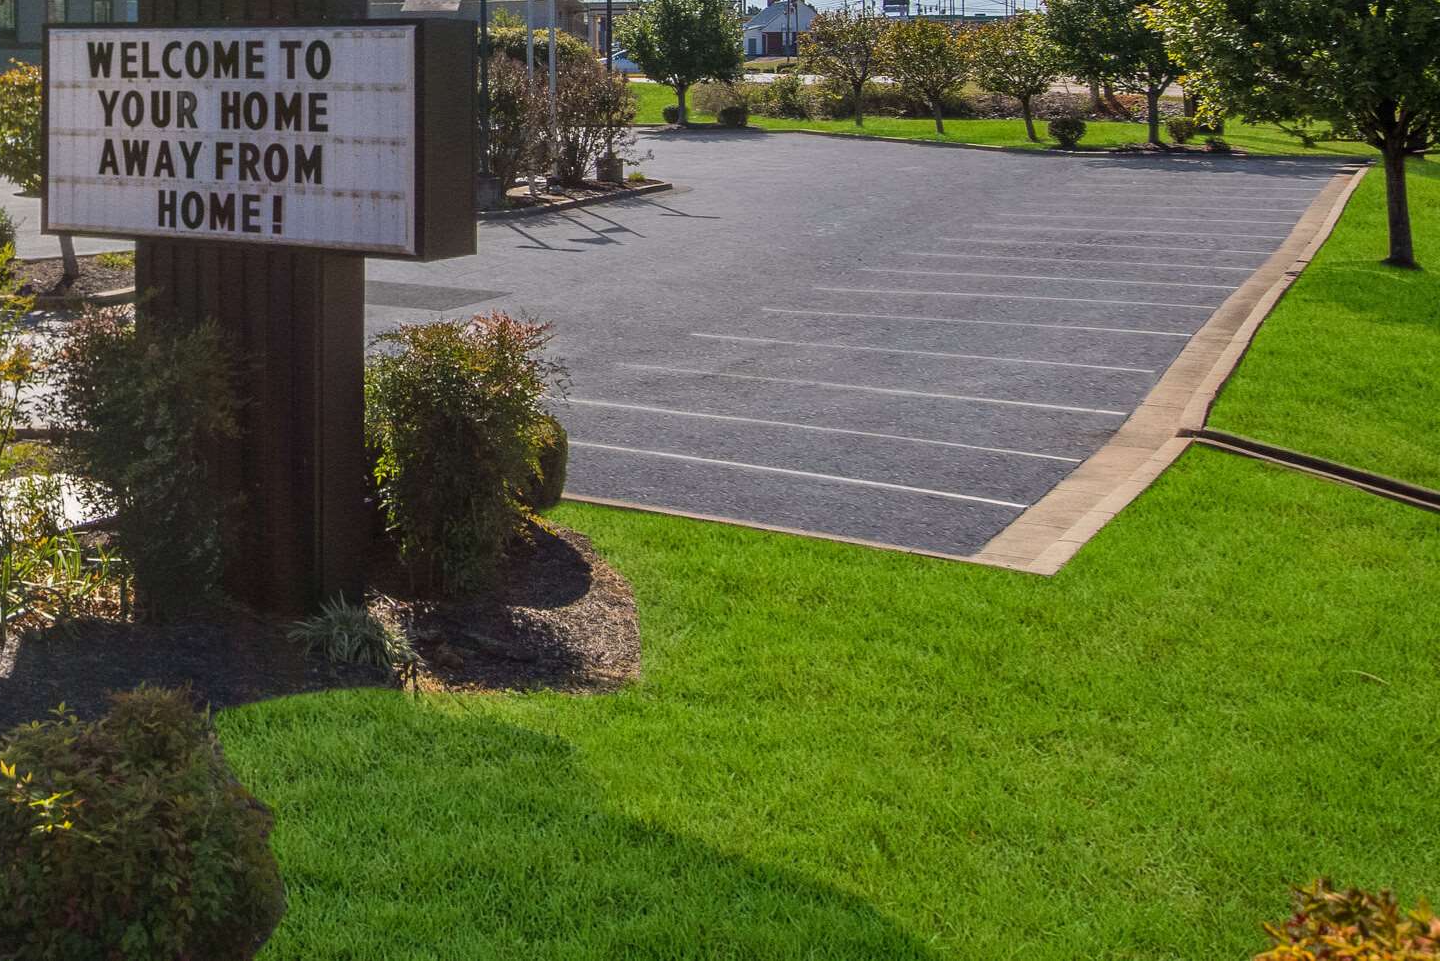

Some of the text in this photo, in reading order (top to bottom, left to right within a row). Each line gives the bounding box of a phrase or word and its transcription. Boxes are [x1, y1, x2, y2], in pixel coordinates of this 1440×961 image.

[87, 40, 332, 80] WELCOME TO
[98, 90, 329, 132] YOUR HOME
[99, 139, 323, 185] AWAY FROM
[158, 190, 283, 235] HOME!
